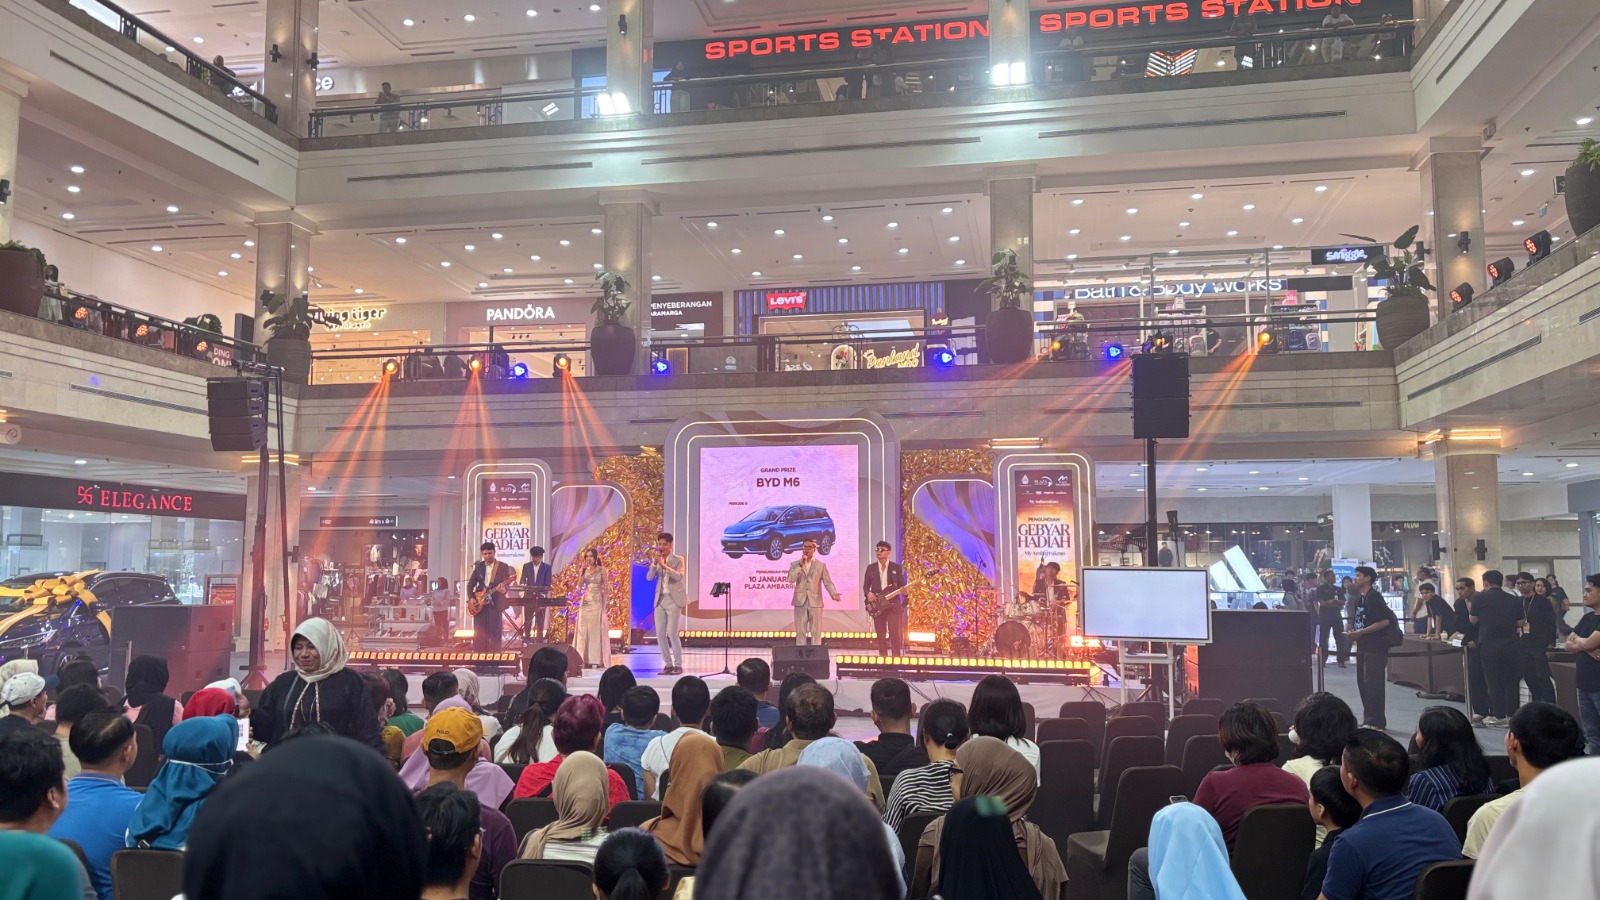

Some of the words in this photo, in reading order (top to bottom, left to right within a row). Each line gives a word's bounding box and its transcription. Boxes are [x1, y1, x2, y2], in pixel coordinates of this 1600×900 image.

[1039, 2, 1190, 33] SPORTS
[1201, 0, 1364, 18] STATI
[705, 32, 840, 60] SPORTS
[851, 20, 990, 48] STATION
[352, 303, 385, 321] tiger
[487, 304, 555, 321] PANDORA
[756, 478, 780, 487] BYD
[783, 477, 800, 487] M6
[100, 489, 193, 512] ELEGANCE
[485, 527, 530, 539] GEBYAR
[1018, 523, 1070, 536] GEBYAR
[485, 539, 530, 550] ADIAH
[1018, 535, 1071, 548] HADIAH
